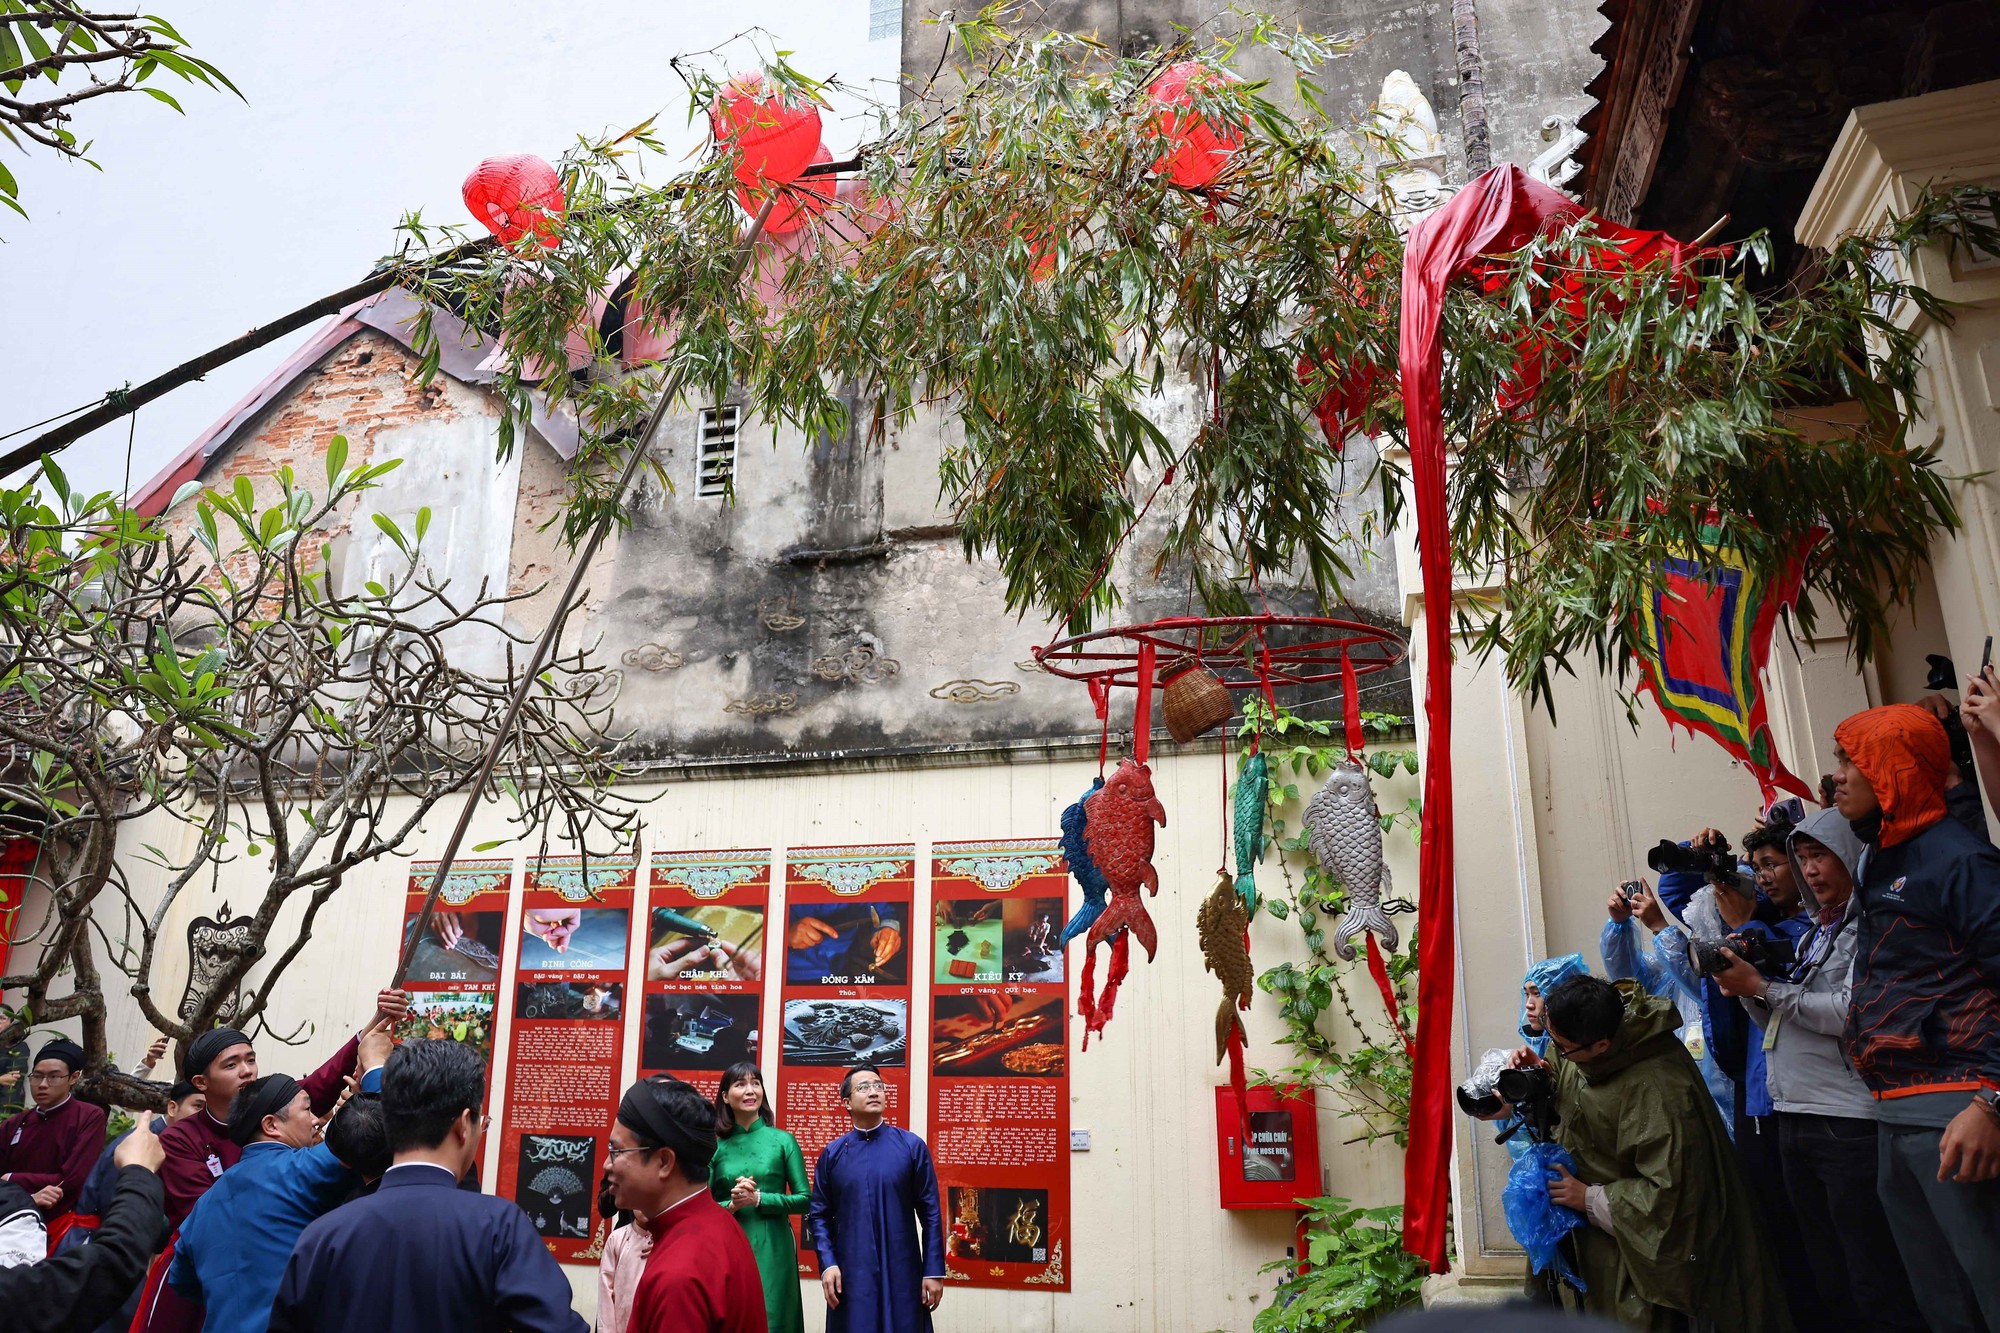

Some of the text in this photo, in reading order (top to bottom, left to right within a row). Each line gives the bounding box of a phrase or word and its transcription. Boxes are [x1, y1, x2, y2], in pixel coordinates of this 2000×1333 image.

[542, 959, 592, 969] ĐỊNH CÔNG
[430, 970, 466, 981] ĐẠI BÁI
[680, 969, 728, 978] CHÂU KHÊ
[974, 971, 1024, 982] KIÊU KỴ
[482, 982, 496, 990] KHÍ
[1258, 1131, 1273, 1142] CHỮA
[1274, 1131, 1287, 1142] CHÁY
